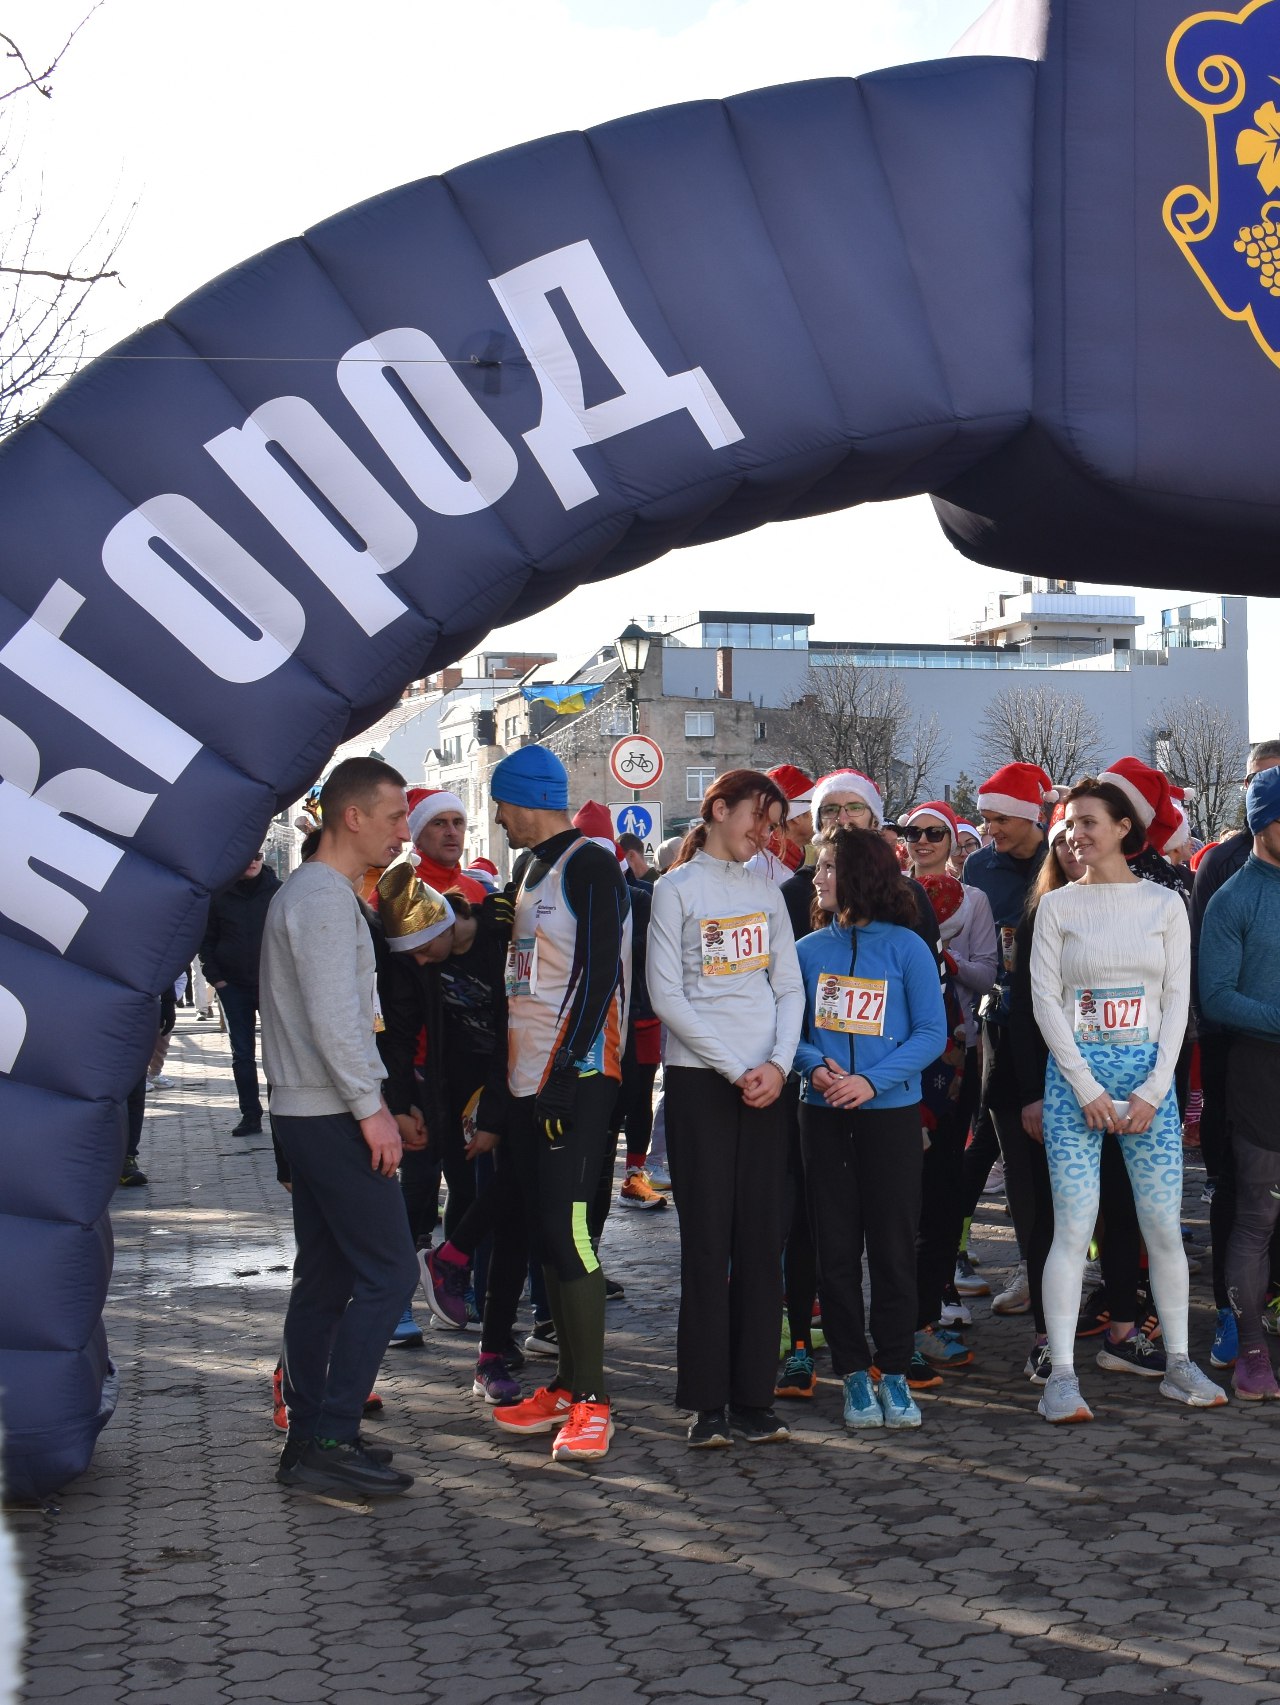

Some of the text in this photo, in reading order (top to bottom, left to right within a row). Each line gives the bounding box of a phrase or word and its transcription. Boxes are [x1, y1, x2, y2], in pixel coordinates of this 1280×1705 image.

[731, 925, 763, 959] 131
[845, 989, 884, 1021] 127
[1103, 998, 1142, 1029] 027
